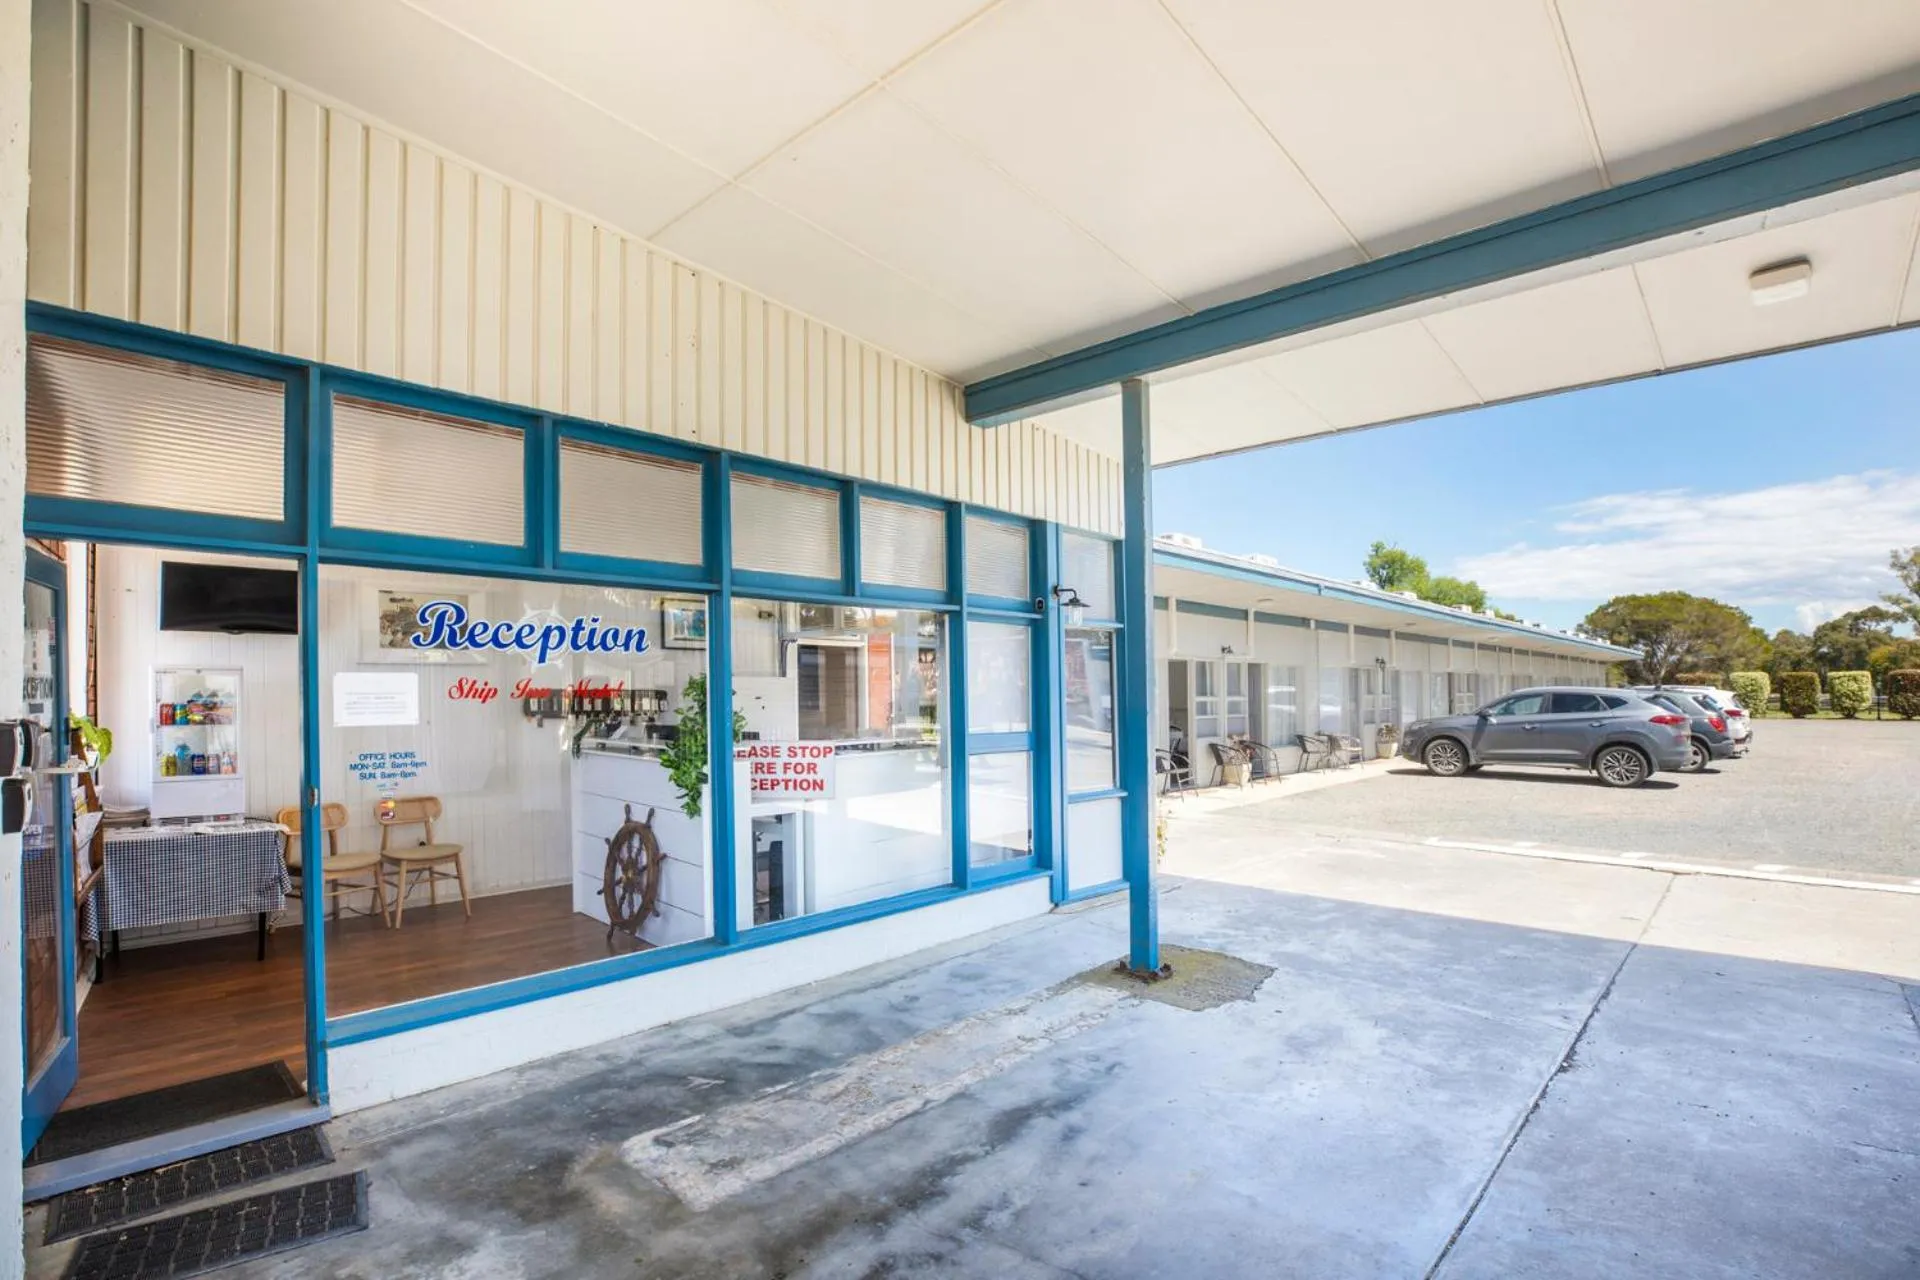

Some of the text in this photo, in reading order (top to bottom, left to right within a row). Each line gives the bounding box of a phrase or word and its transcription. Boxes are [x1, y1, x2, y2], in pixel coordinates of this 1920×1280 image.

[410, 600, 650, 666] Reception
[448, 676, 498, 704] Ship
[510, 677, 553, 699] Inn
[359, 752, 416, 761] OFFICE HOURS
[733, 745, 833, 758] EASE STOP
[751, 762, 817, 774] RE FOR
